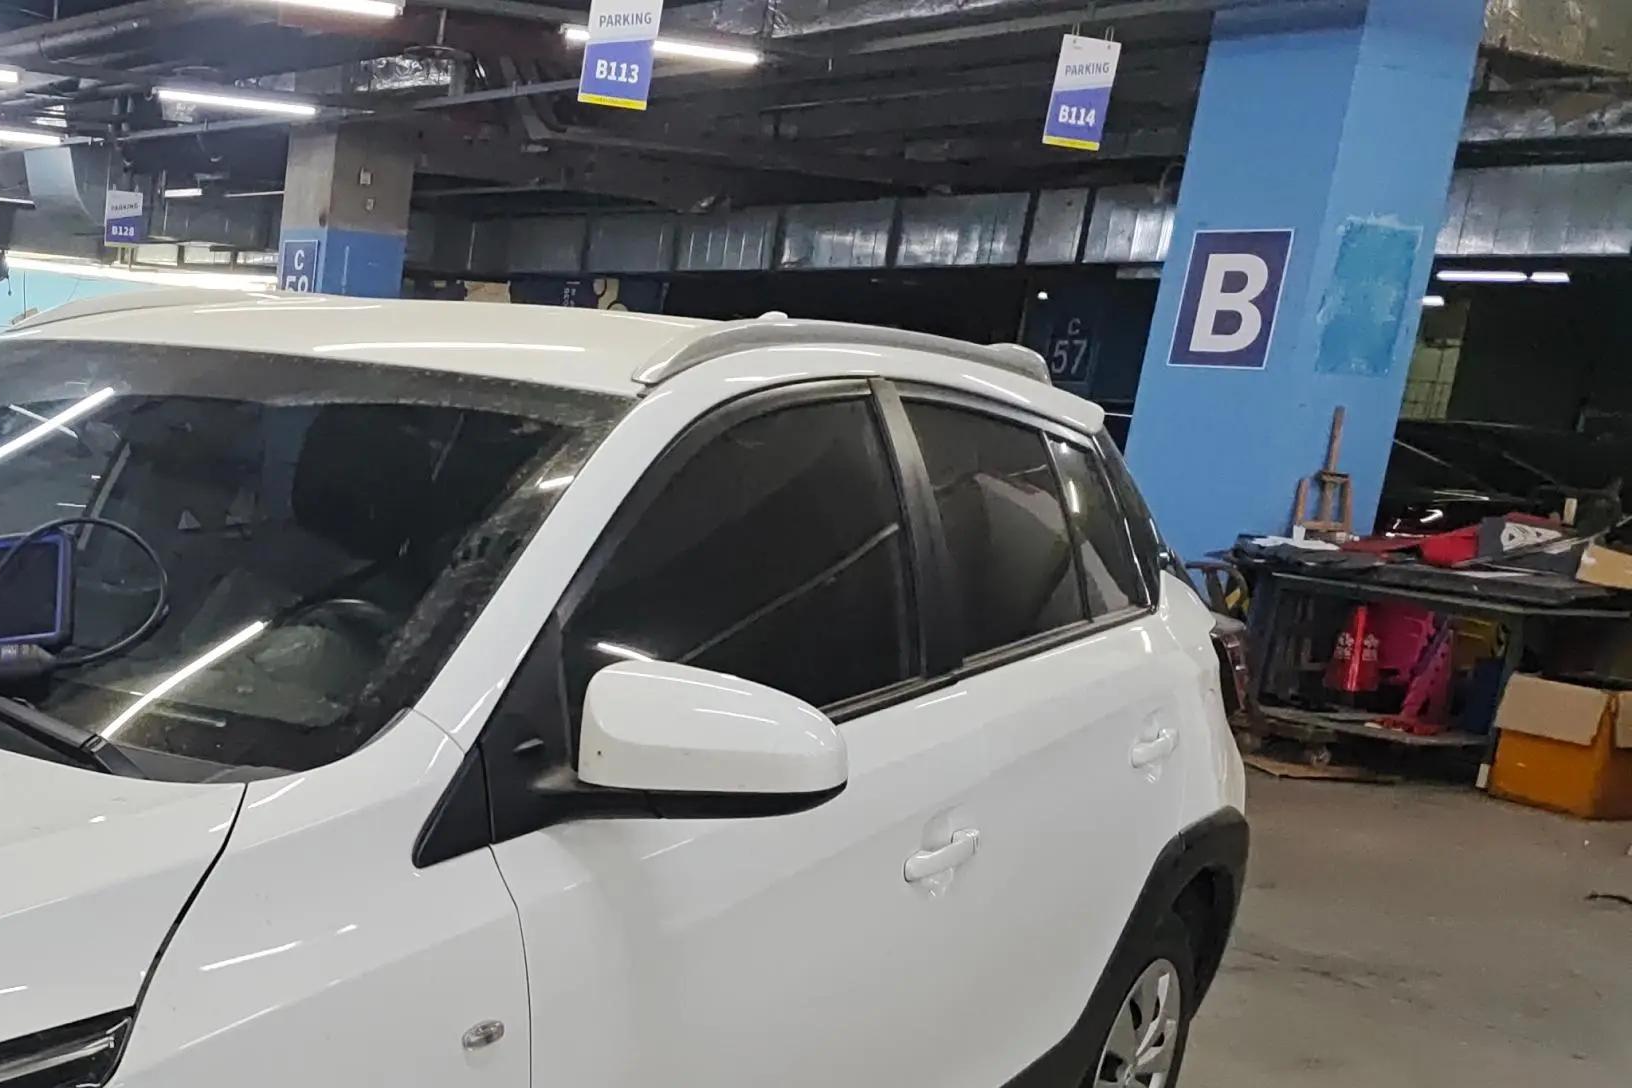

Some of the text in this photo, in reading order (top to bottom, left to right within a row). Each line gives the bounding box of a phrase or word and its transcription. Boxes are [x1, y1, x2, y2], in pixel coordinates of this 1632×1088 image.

[599, 12, 652, 28] PARKING
[595, 59, 640, 84] B113
[1065, 62, 1111, 77] PARKING
[1058, 104, 1096, 127] B114
[294, 249, 305, 271] C
[1189, 253, 1269, 352] B
[1068, 317, 1081, 335] C
[1051, 340, 1087, 375] 57
